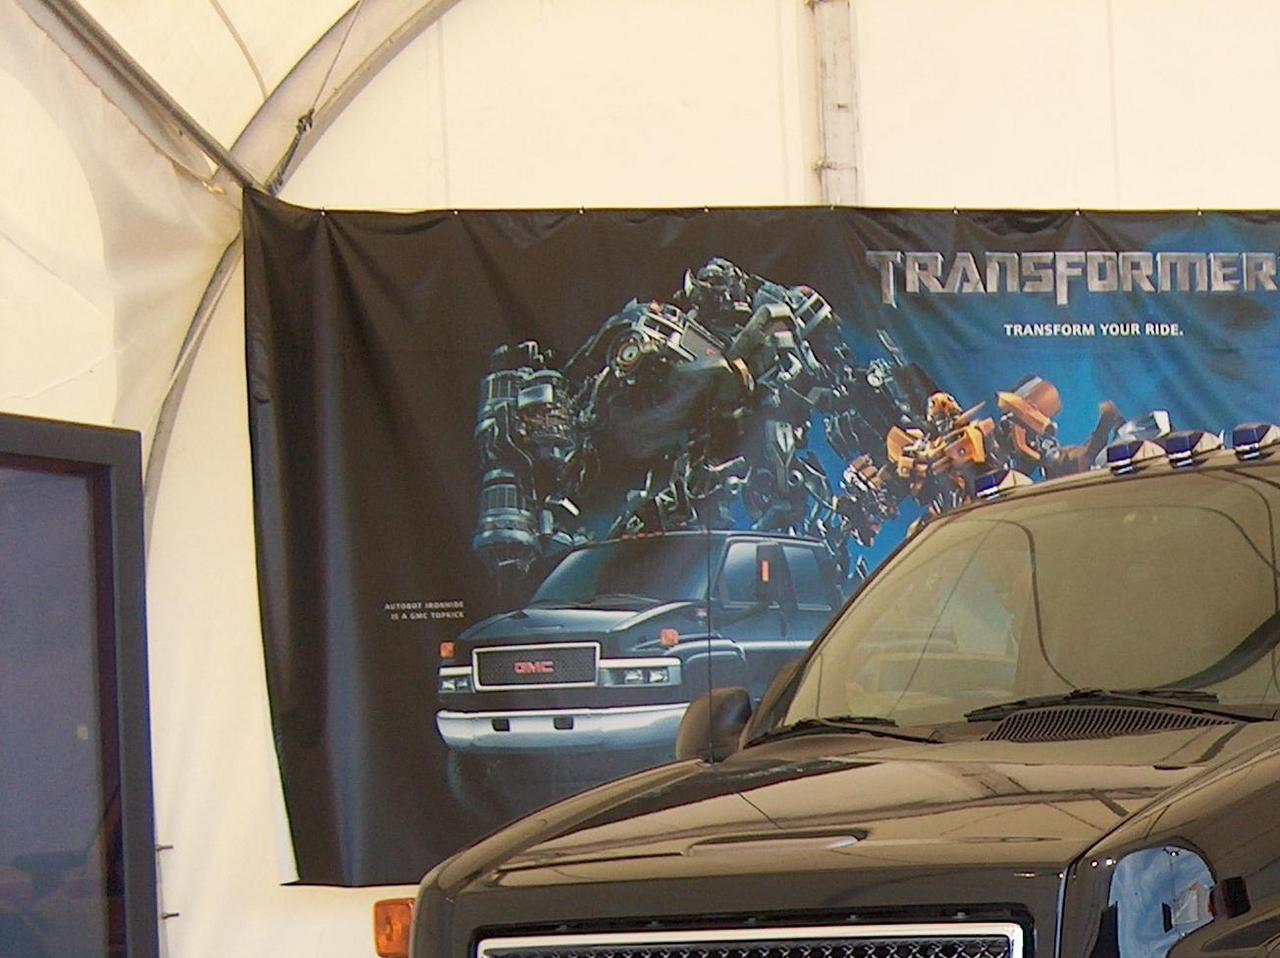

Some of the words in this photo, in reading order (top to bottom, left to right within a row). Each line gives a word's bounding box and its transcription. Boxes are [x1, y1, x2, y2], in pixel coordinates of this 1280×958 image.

[1004, 324, 1095, 336] TRANSFORM
[1101, 323, 1140, 336] YOUR
[1145, 323, 1184, 335] RIDE.
[514, 661, 553, 674] GMC
